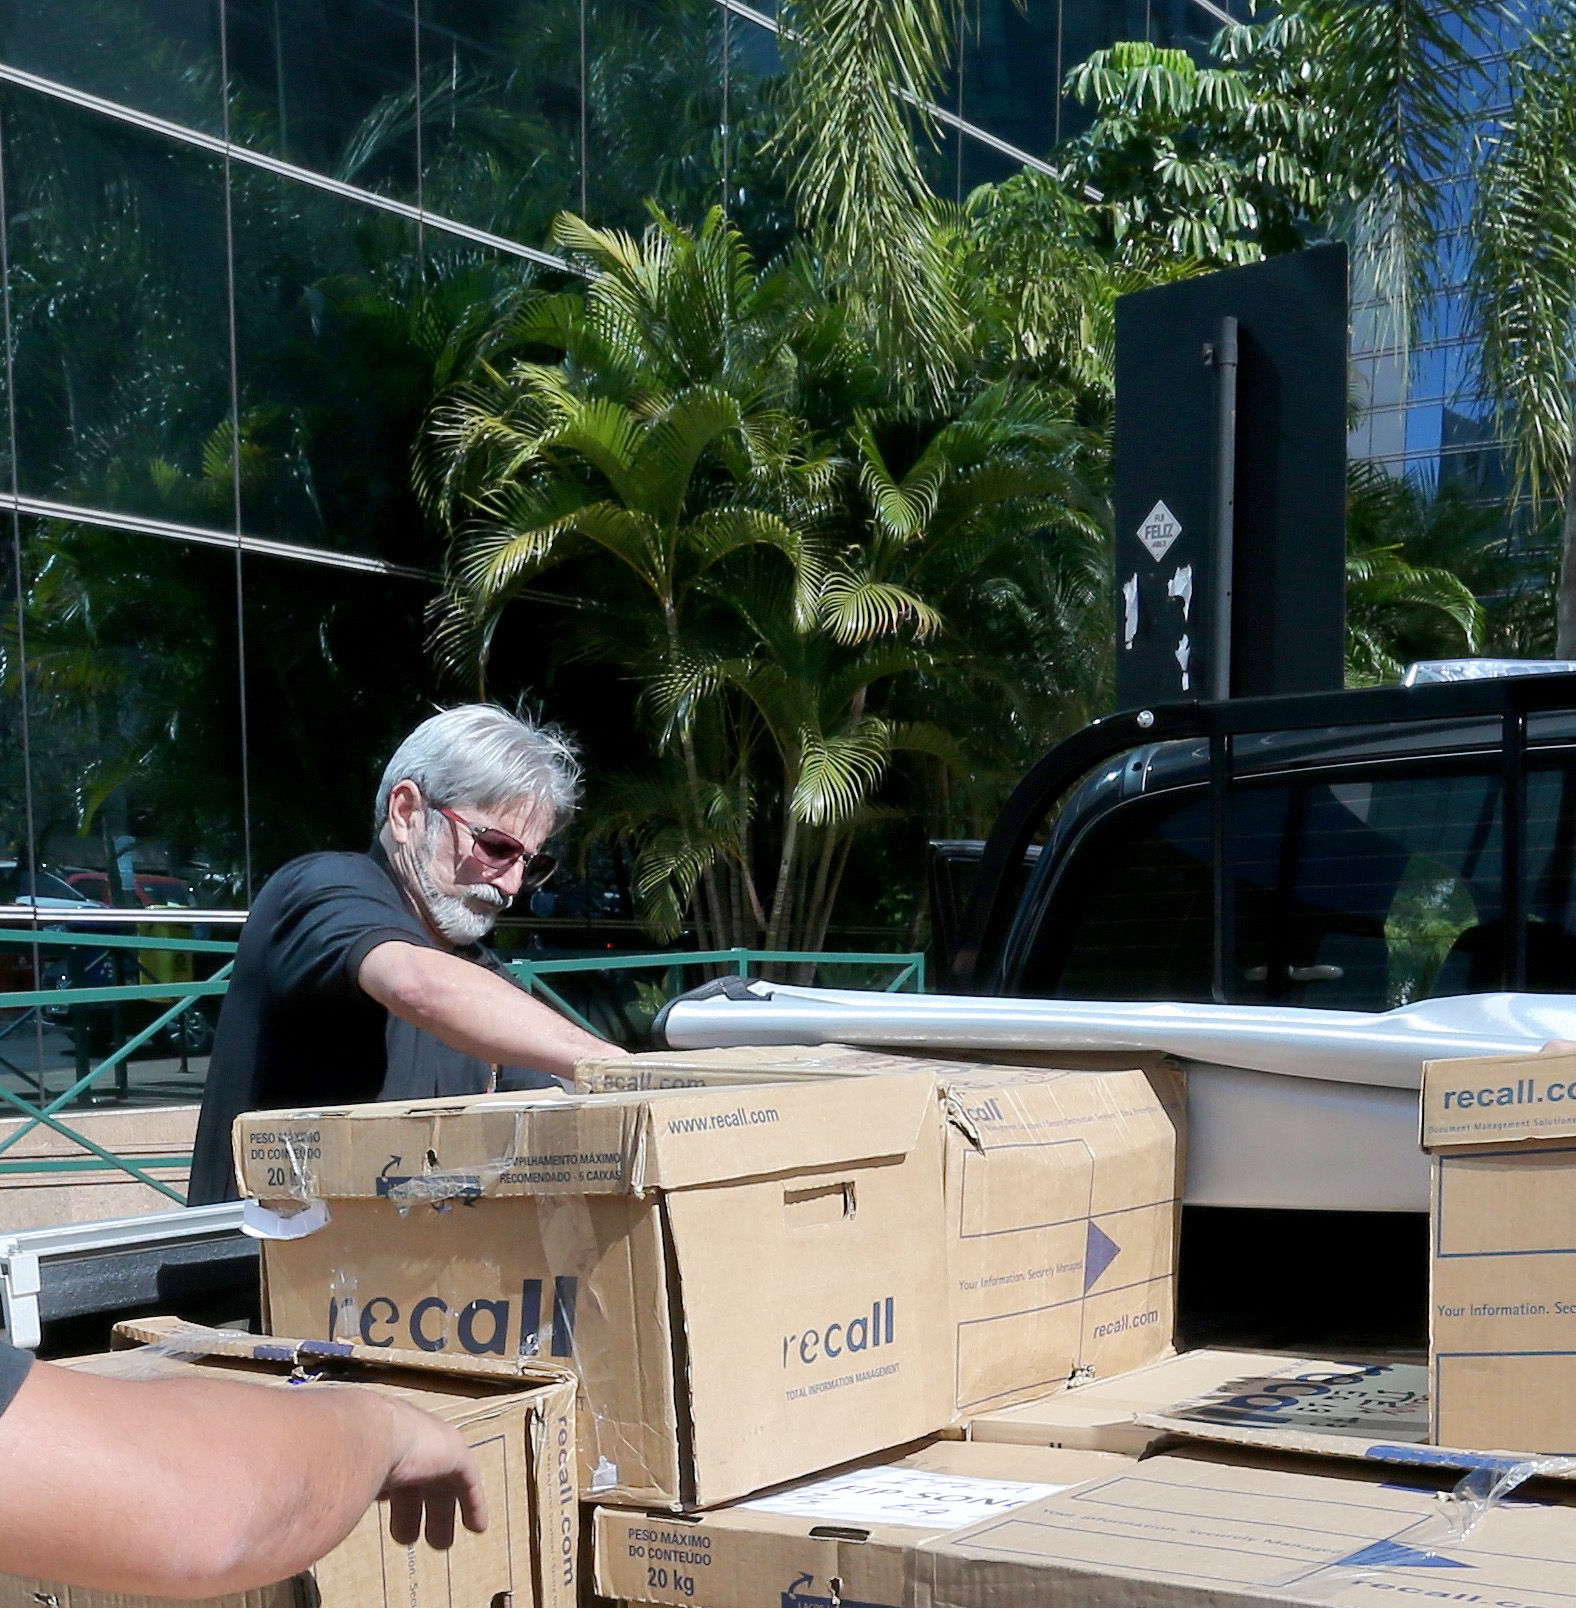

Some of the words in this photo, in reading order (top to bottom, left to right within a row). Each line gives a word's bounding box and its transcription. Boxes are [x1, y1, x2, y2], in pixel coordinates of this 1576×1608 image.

[667, 1106, 780, 1135] www.recall.com
[1427, 1123, 1471, 1134] Document
[1474, 1119, 1530, 1132] Management
[1533, 1115, 1576, 1127] Solutions
[249, 1132, 275, 1143] PESO
[251, 1149, 265, 1159] DO
[503, 1155, 577, 1167] MPILHAMENTO
[267, 1167, 285, 1186] 20
[499, 1171, 571, 1184] RECOMENDADO
[586, 1169, 623, 1182] CAIXAS
[958, 1277, 979, 1290] Your
[1437, 1303, 1465, 1317] Your
[1470, 1302, 1550, 1316] Information.
[783, 1296, 894, 1369] recall
[1093, 1308, 1159, 1339] recall.com
[786, 1387, 808, 1401] TOTAL
[808, 1374, 855, 1396] INFORMATION
[855, 1362, 901, 1385] MANAGEMENT
[557, 1414, 574, 1587] recall.com
[628, 1528, 658, 1543] PESO
[660, 1530, 711, 1549] MÁXIMO
[629, 1545, 645, 1558] DO
[647, 1546, 712, 1566] CONTEÚDO
[647, 1566, 668, 1588] 20
[673, 1569, 695, 1597] kg
